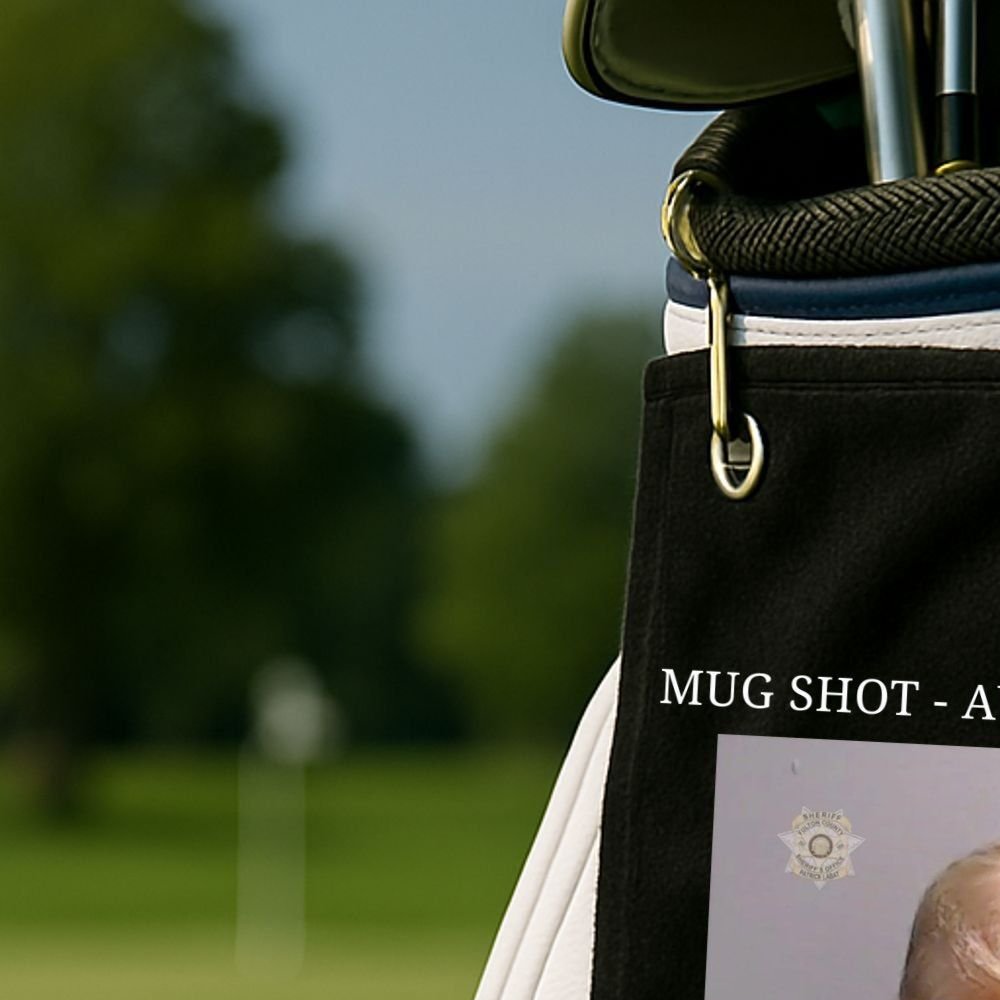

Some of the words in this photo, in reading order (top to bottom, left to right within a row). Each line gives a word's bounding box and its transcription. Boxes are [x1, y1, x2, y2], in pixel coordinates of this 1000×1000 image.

[660, 669, 774, 709] MUG
[789, 675, 920, 717] SHOT
[802, 811, 841, 820] SHERIFF
